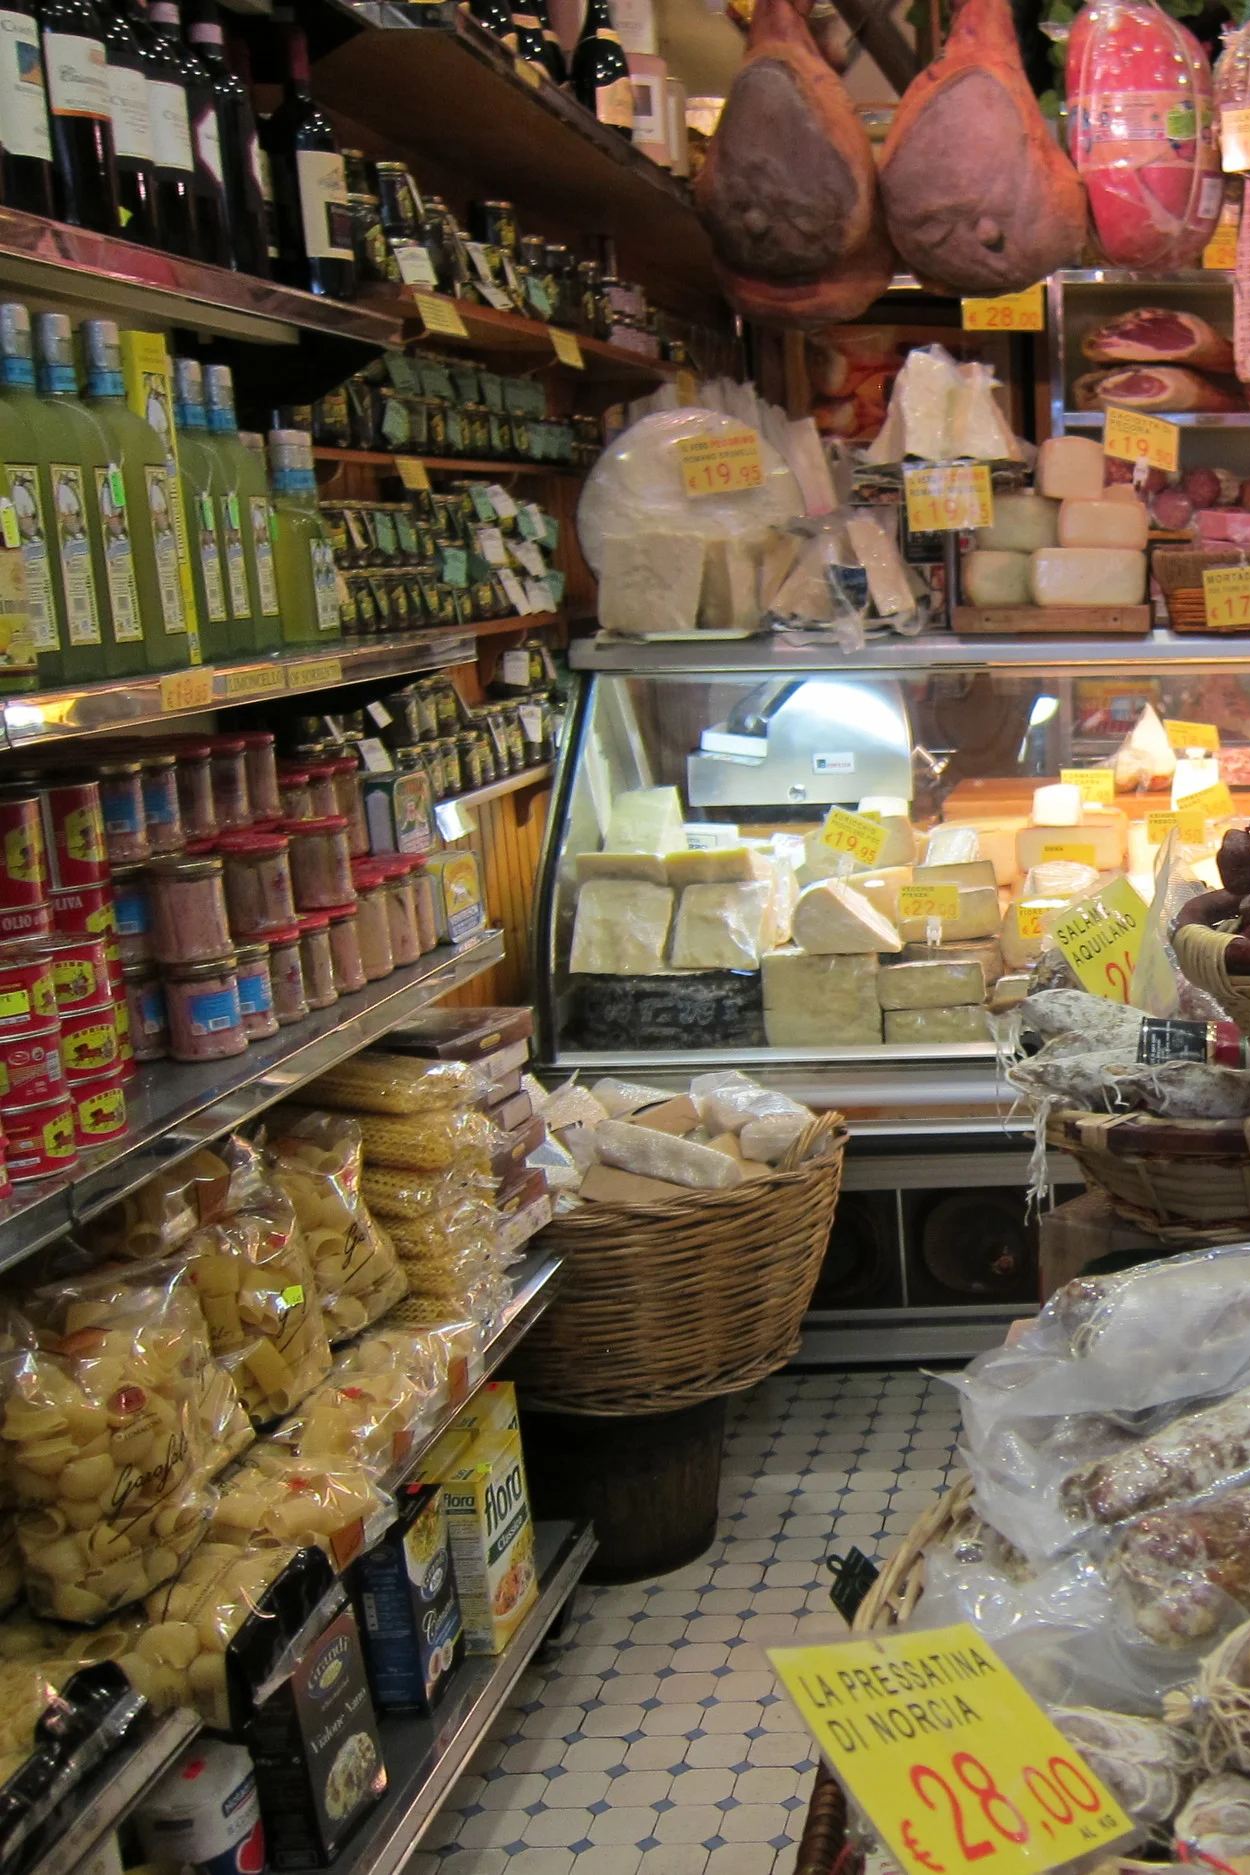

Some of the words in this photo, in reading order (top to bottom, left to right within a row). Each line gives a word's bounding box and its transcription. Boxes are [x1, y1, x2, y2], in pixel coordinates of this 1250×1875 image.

[1072, 913, 1137, 968] AQUILANO
[444, 1493, 475, 1507] flora
[484, 1464, 523, 1537] flora
[799, 1674, 844, 1709] LA
[836, 1647, 997, 1702] PRESSATINA
[826, 1719, 869, 1753] DI
[866, 1694, 984, 1745] NORCIA
[900, 1751, 1101, 1874] €28,00
[1098, 1814, 1118, 1831] KG
